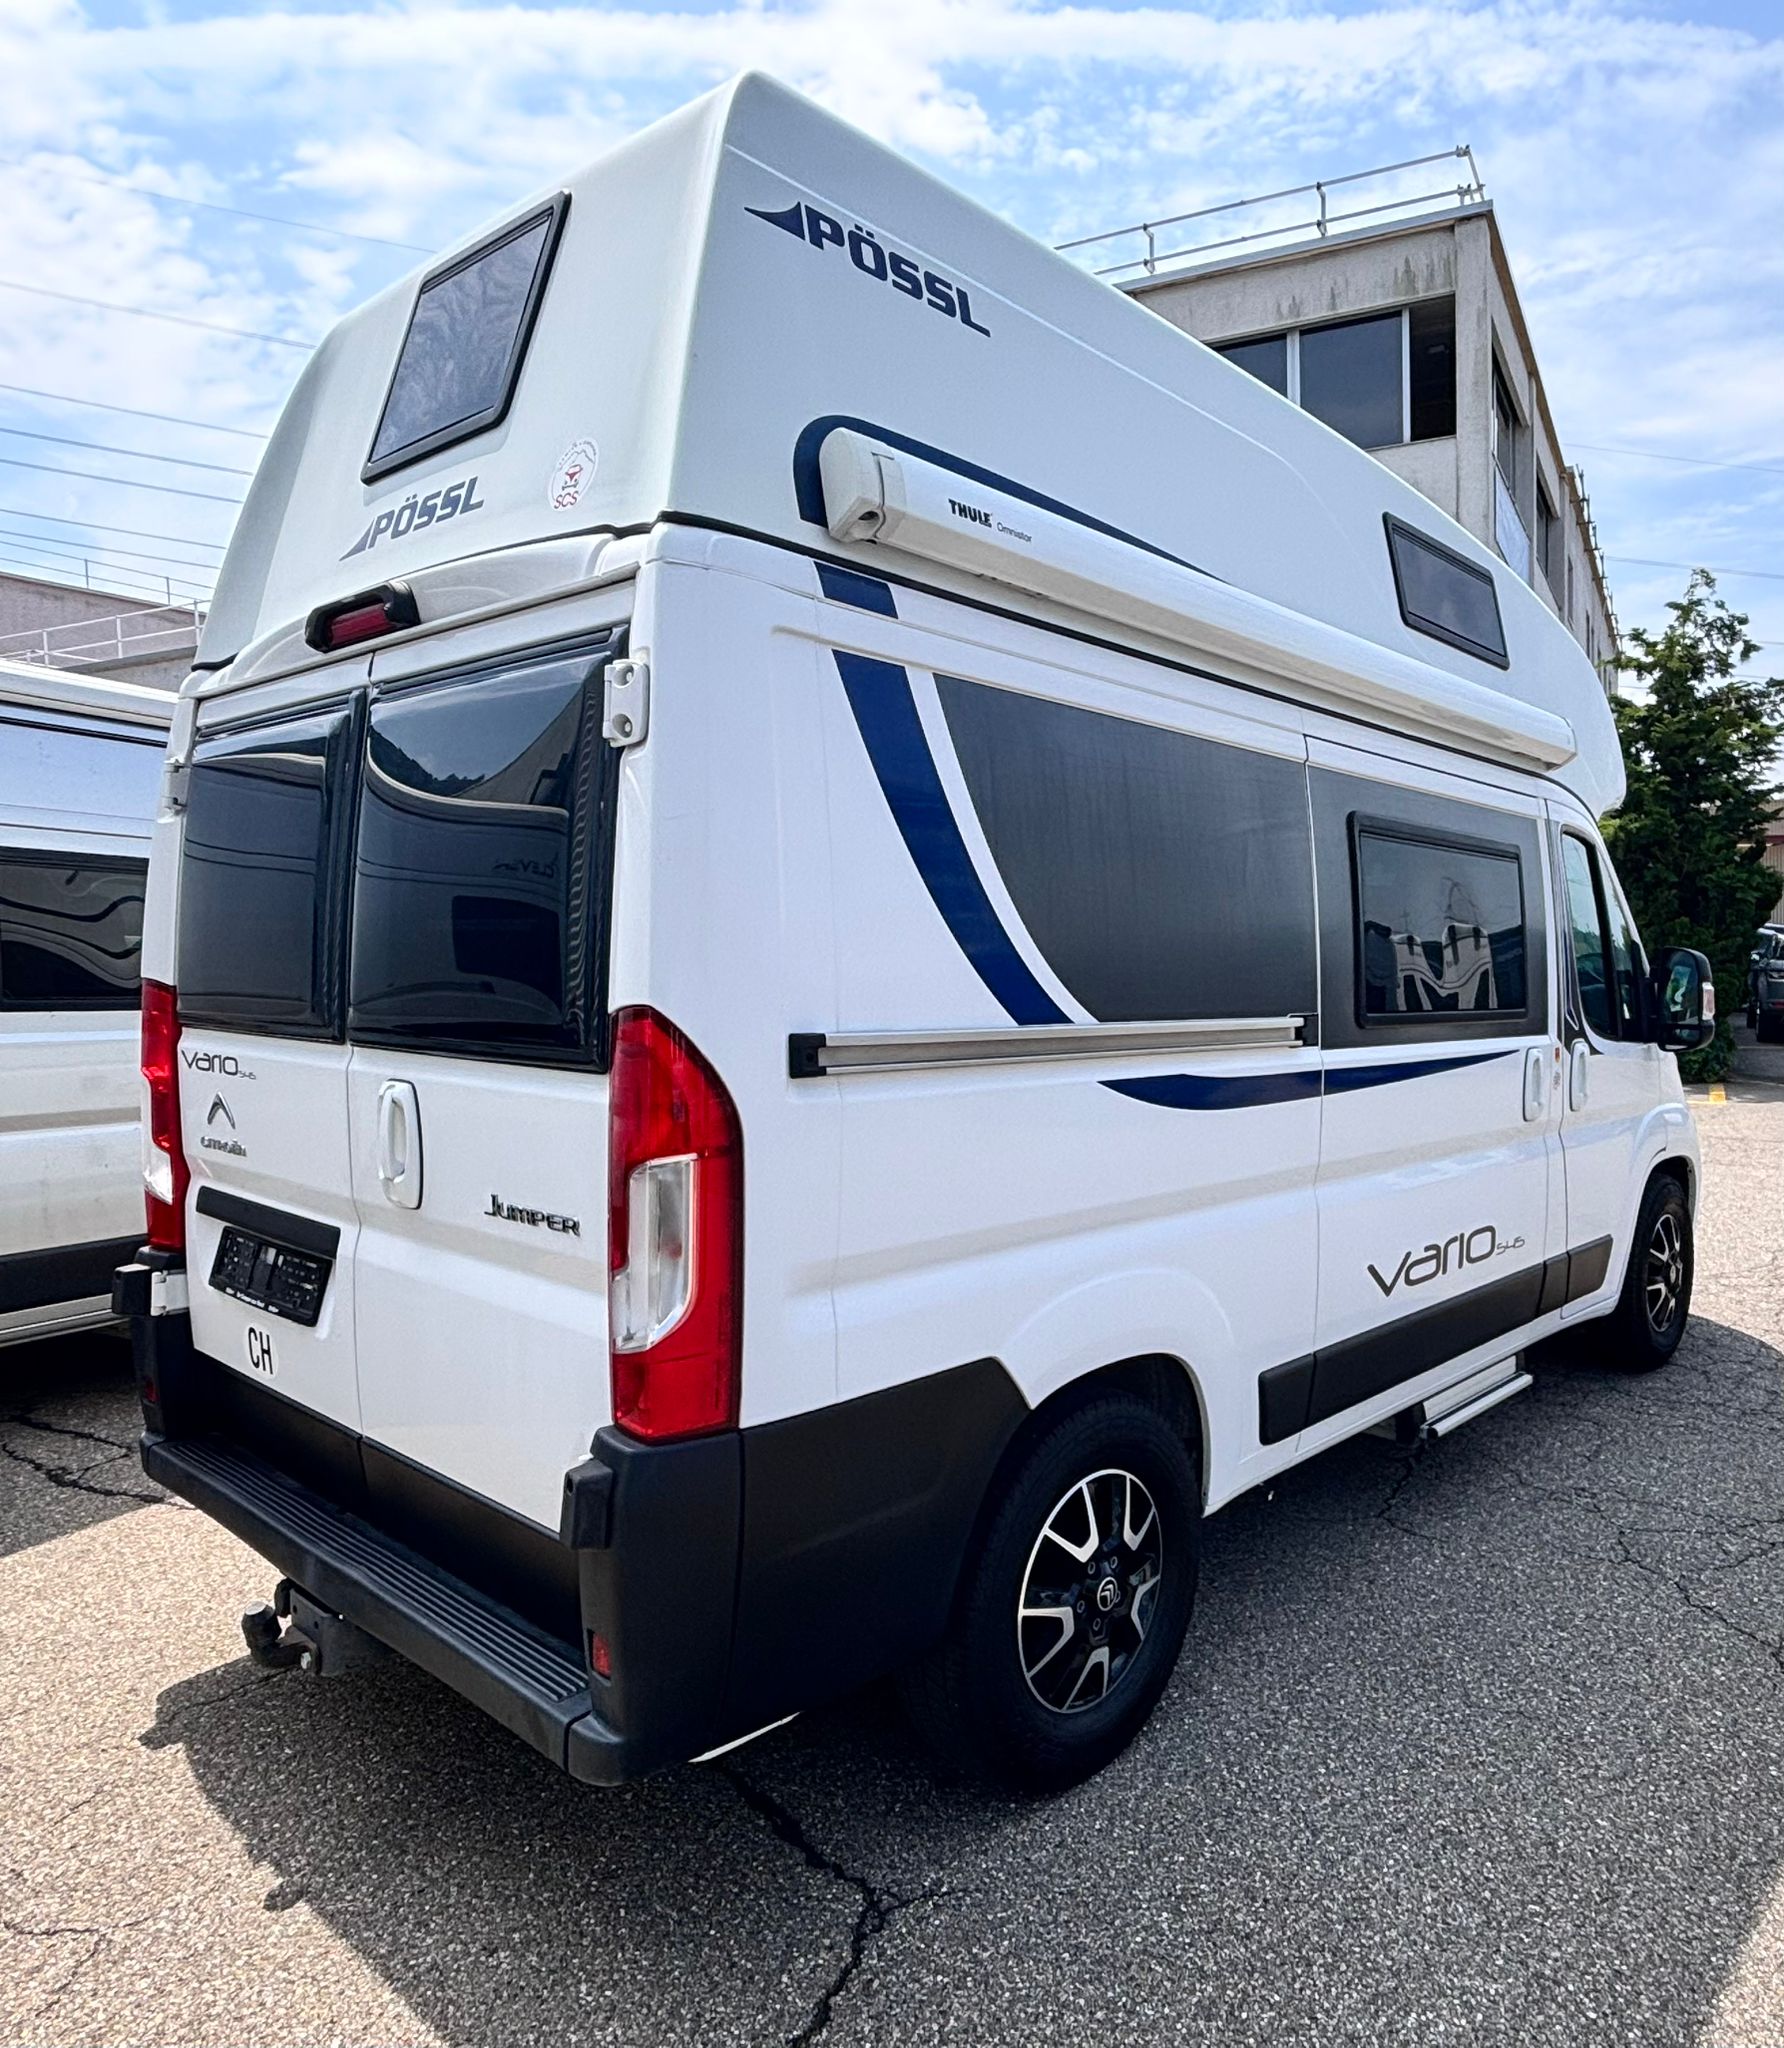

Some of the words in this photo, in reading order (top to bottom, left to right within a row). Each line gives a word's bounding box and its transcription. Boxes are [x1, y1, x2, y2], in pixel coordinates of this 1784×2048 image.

[803, 204, 991, 338] PÖSSL
[367, 475, 485, 550] PÖSSL
[553, 490, 580, 510] SCS
[947, 498, 992, 526] THULE
[996, 521, 1033, 542] Omnistor
[248, 1326, 273, 1375] CH
